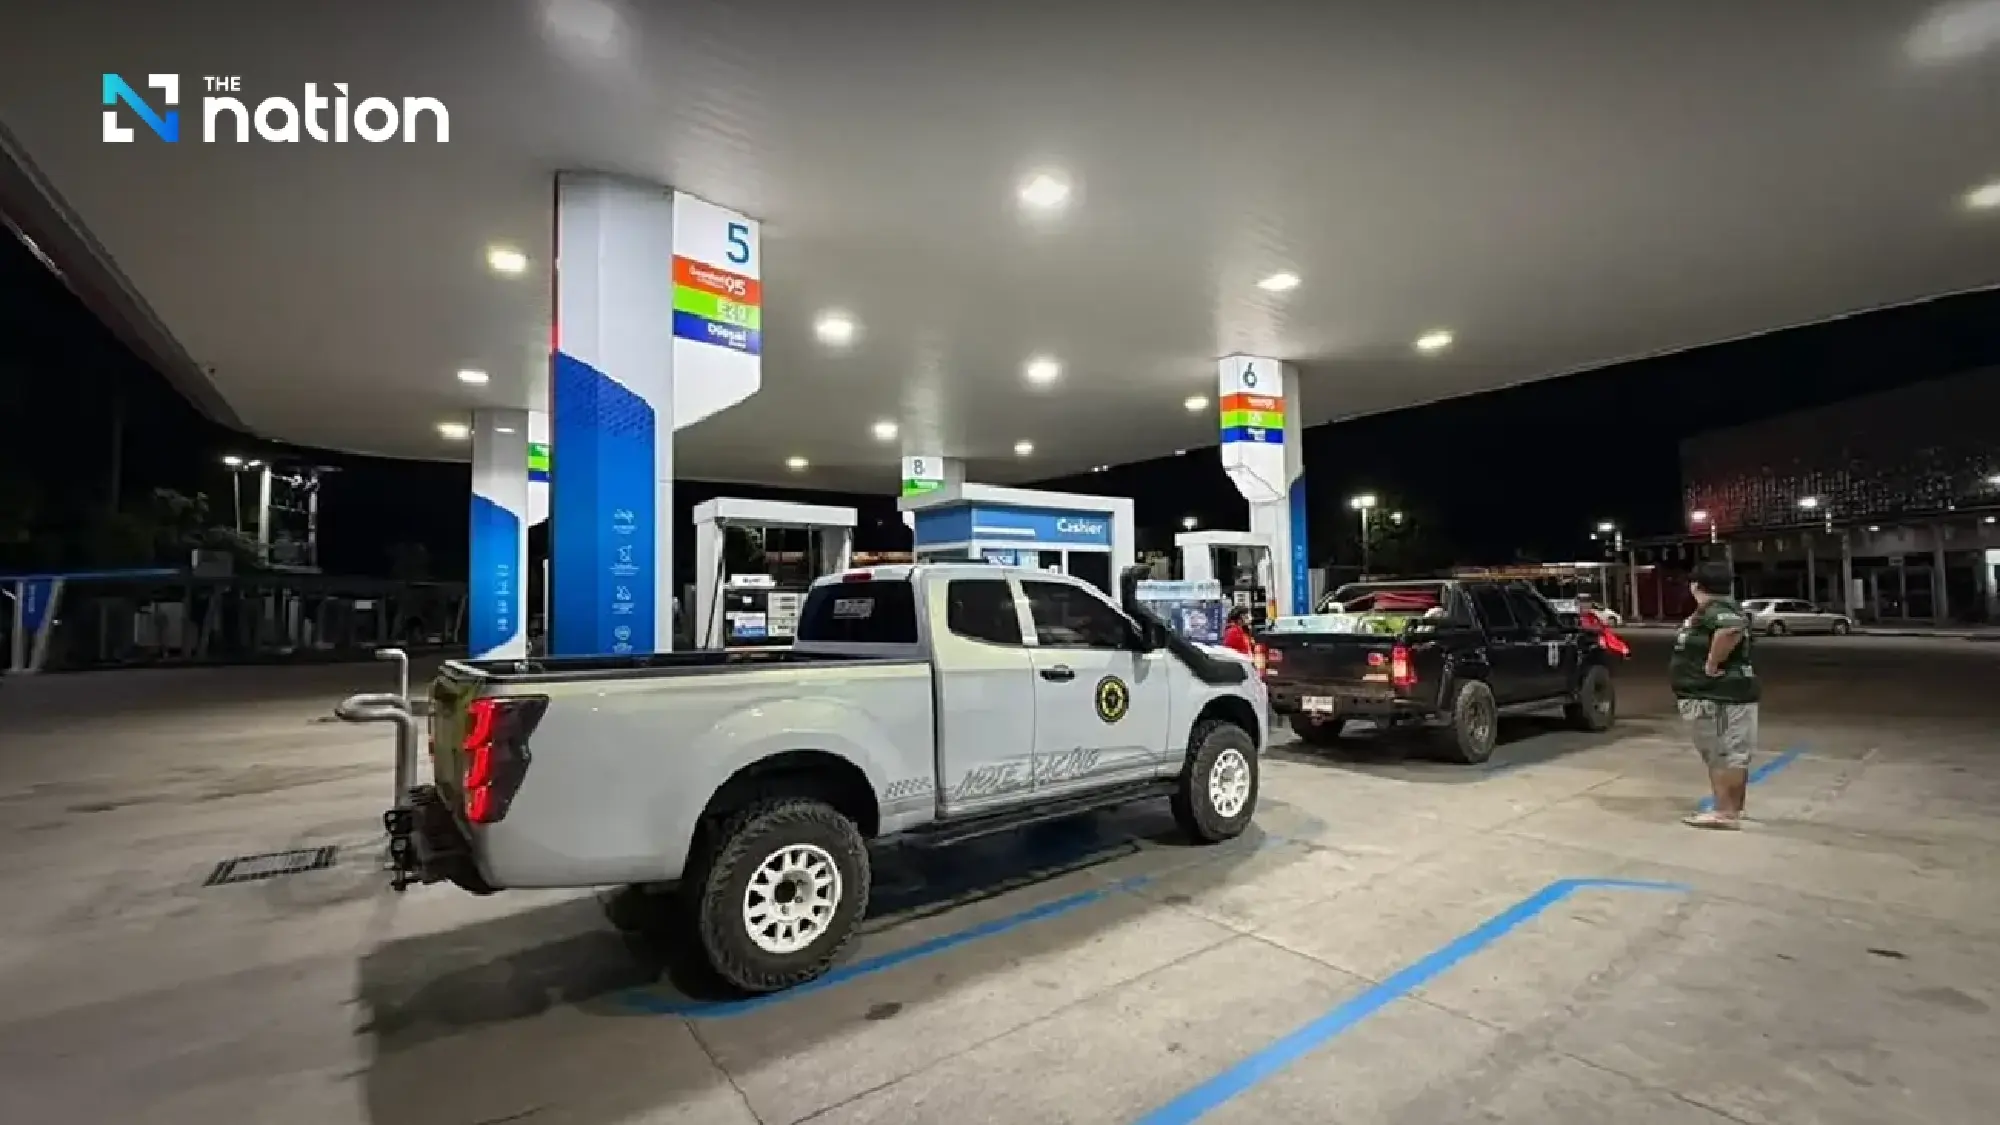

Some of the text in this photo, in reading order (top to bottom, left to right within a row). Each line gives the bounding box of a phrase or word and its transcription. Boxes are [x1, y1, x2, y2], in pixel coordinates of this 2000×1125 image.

[726, 222, 750, 264] 5
[725, 277, 746, 296] 95
[1242, 361, 1258, 388] 6
[913, 458, 926, 476] 8
[1056, 516, 1103, 535] Cashier
